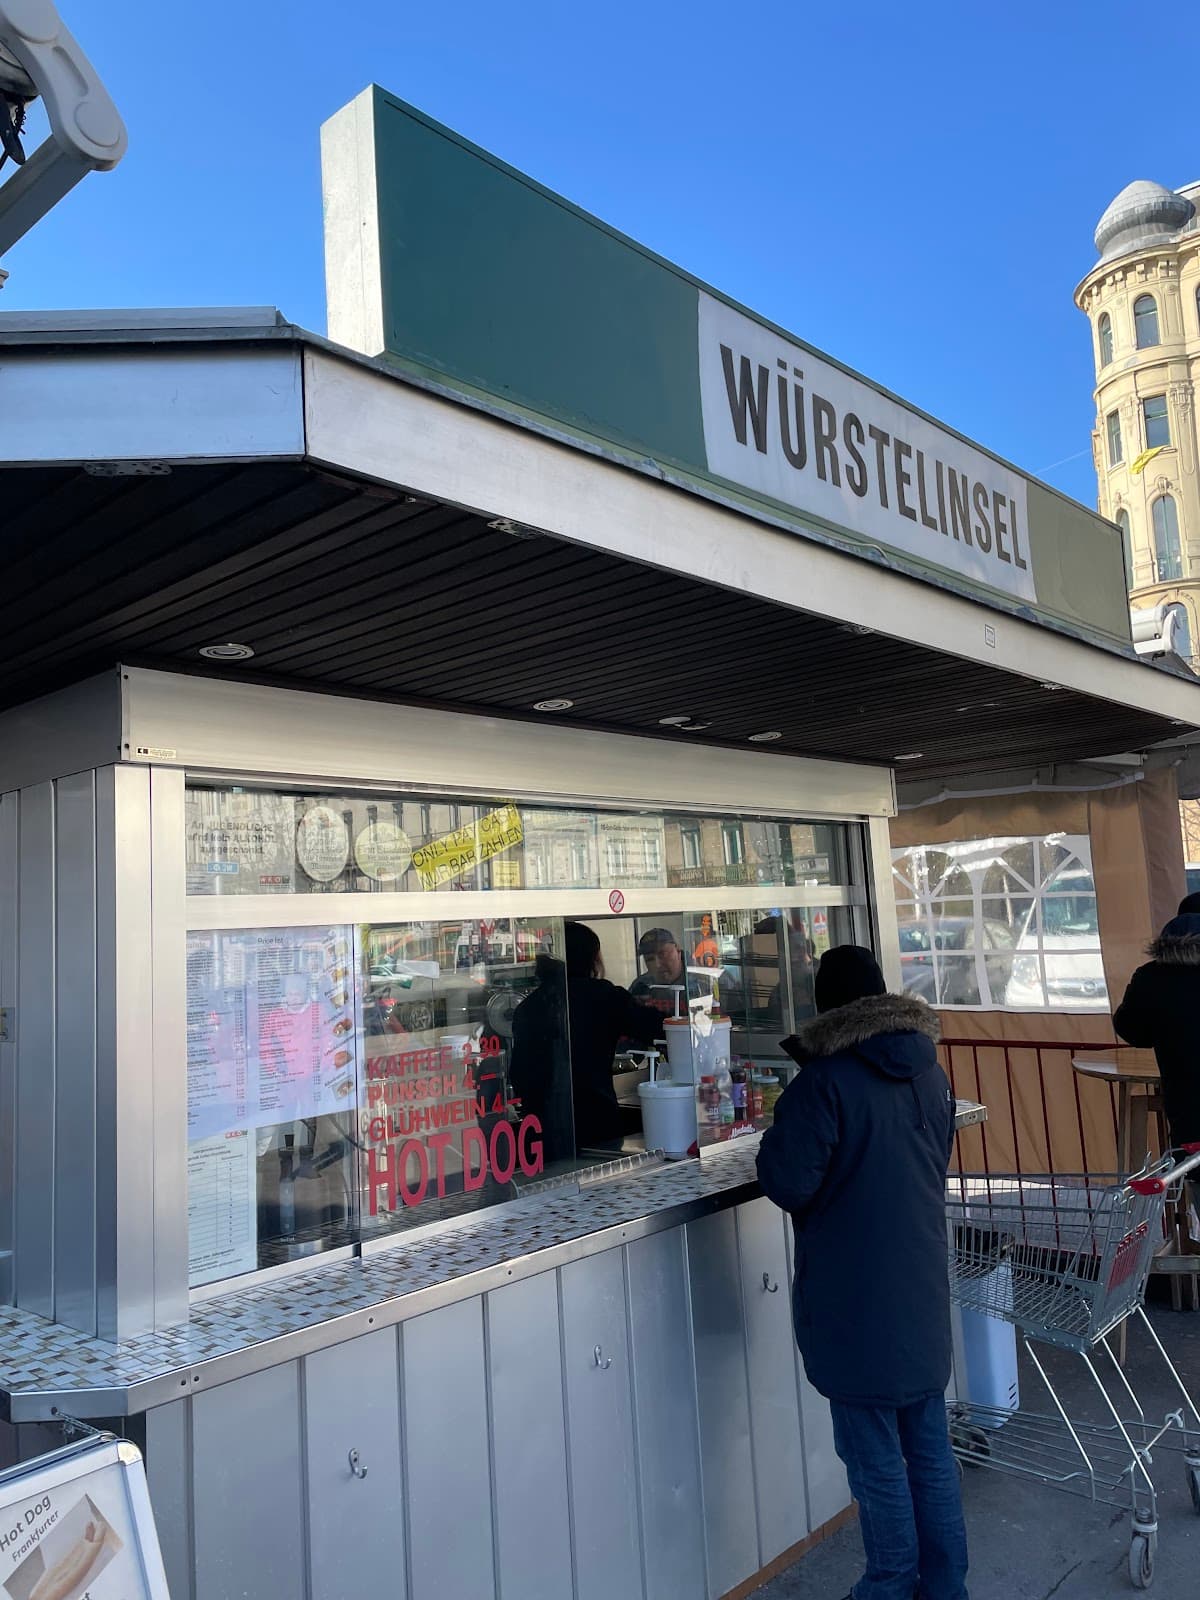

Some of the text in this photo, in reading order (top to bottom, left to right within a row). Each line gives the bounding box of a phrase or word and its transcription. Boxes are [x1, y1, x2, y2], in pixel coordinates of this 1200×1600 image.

[719, 343, 1028, 571] WÜRSTELINSEL
[412, 841, 449, 868] ONLY
[452, 824, 476, 847] PAY
[481, 804, 519, 833] CASH
[449, 850, 477, 874] BAR
[480, 824, 522, 858] ZAHLEN
[367, 1046, 453, 1081] KAFFEE
[367, 1075, 457, 1109] PUNSCH
[368, 1096, 486, 1142] GLÜHWEIN
[368, 1113, 544, 1216] HOT DOG
[0, 1495, 53, 1552] Hot Dog
[11, 1510, 60, 1563] Frankfurter
